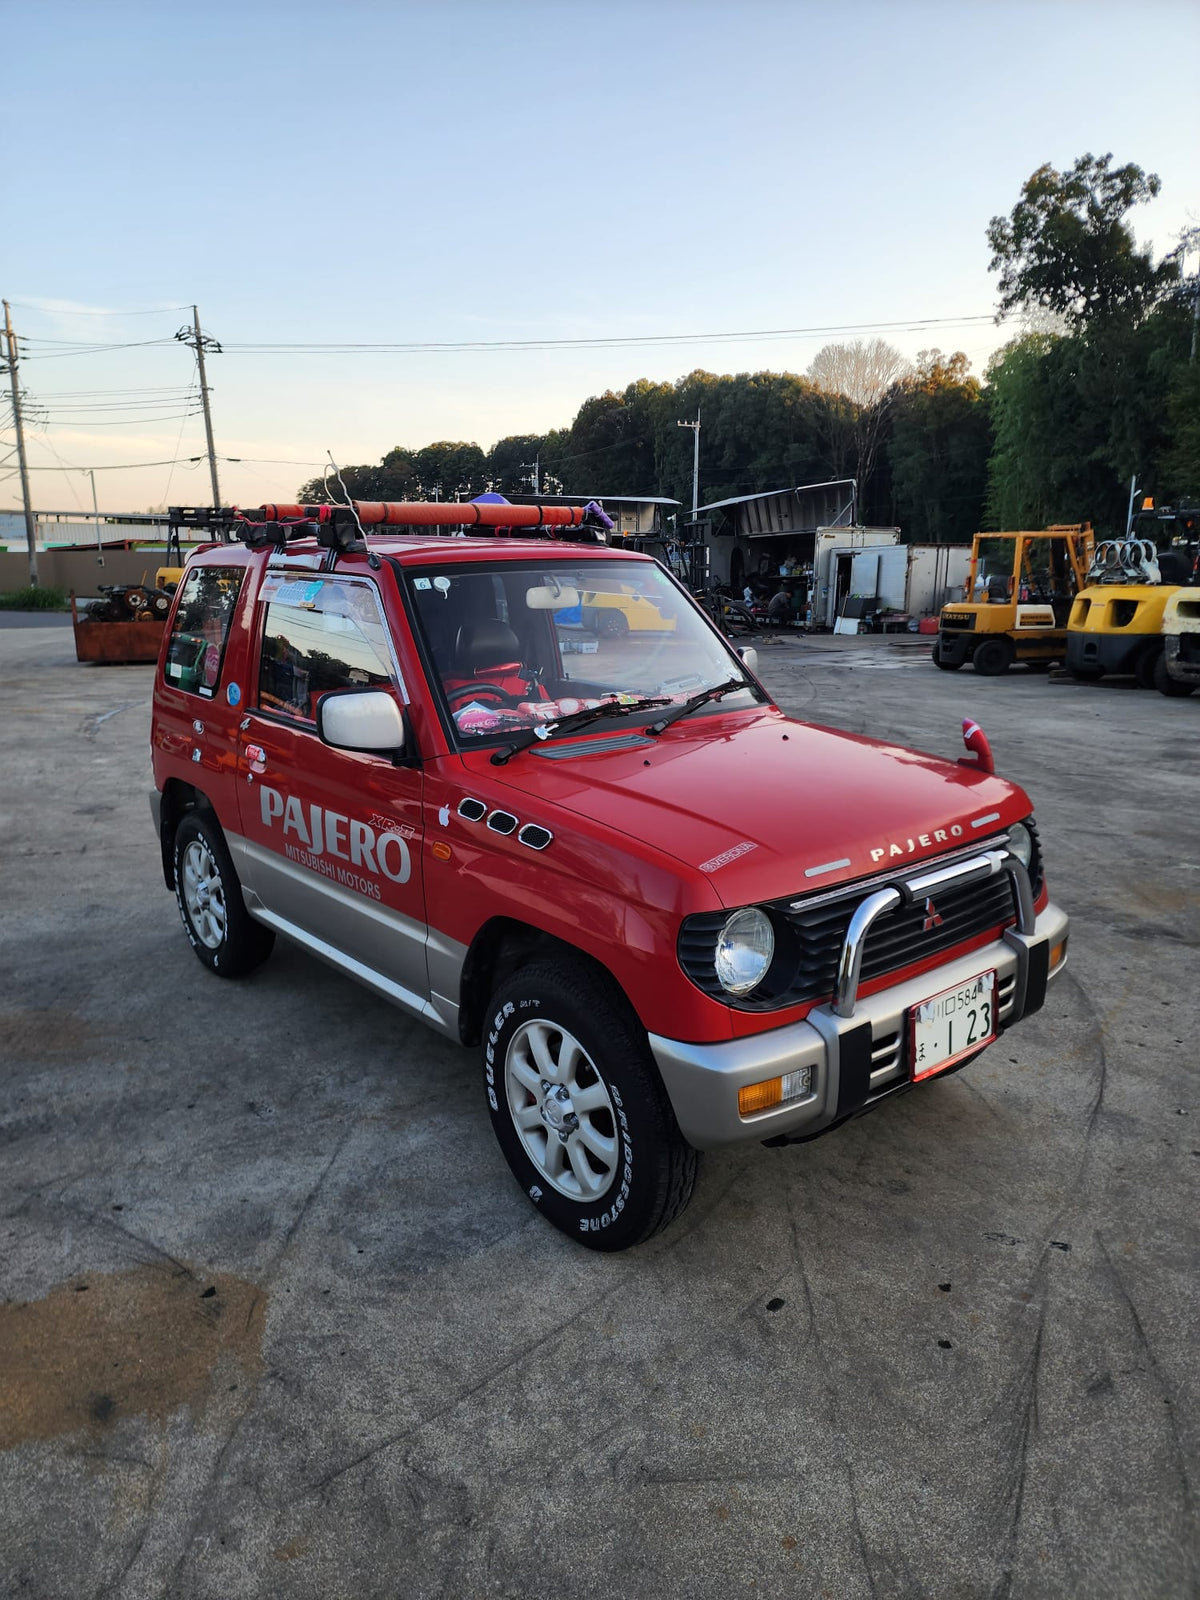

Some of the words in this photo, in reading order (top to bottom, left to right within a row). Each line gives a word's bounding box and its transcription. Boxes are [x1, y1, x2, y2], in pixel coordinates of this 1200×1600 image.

[260, 785, 411, 884] PAJERO
[285, 843, 336, 879] MITSUBISHI
[338, 869, 381, 900] MOTORS
[870, 824, 963, 862] PAJERO
[580, 1083, 633, 1232] BRIDGESTONE
